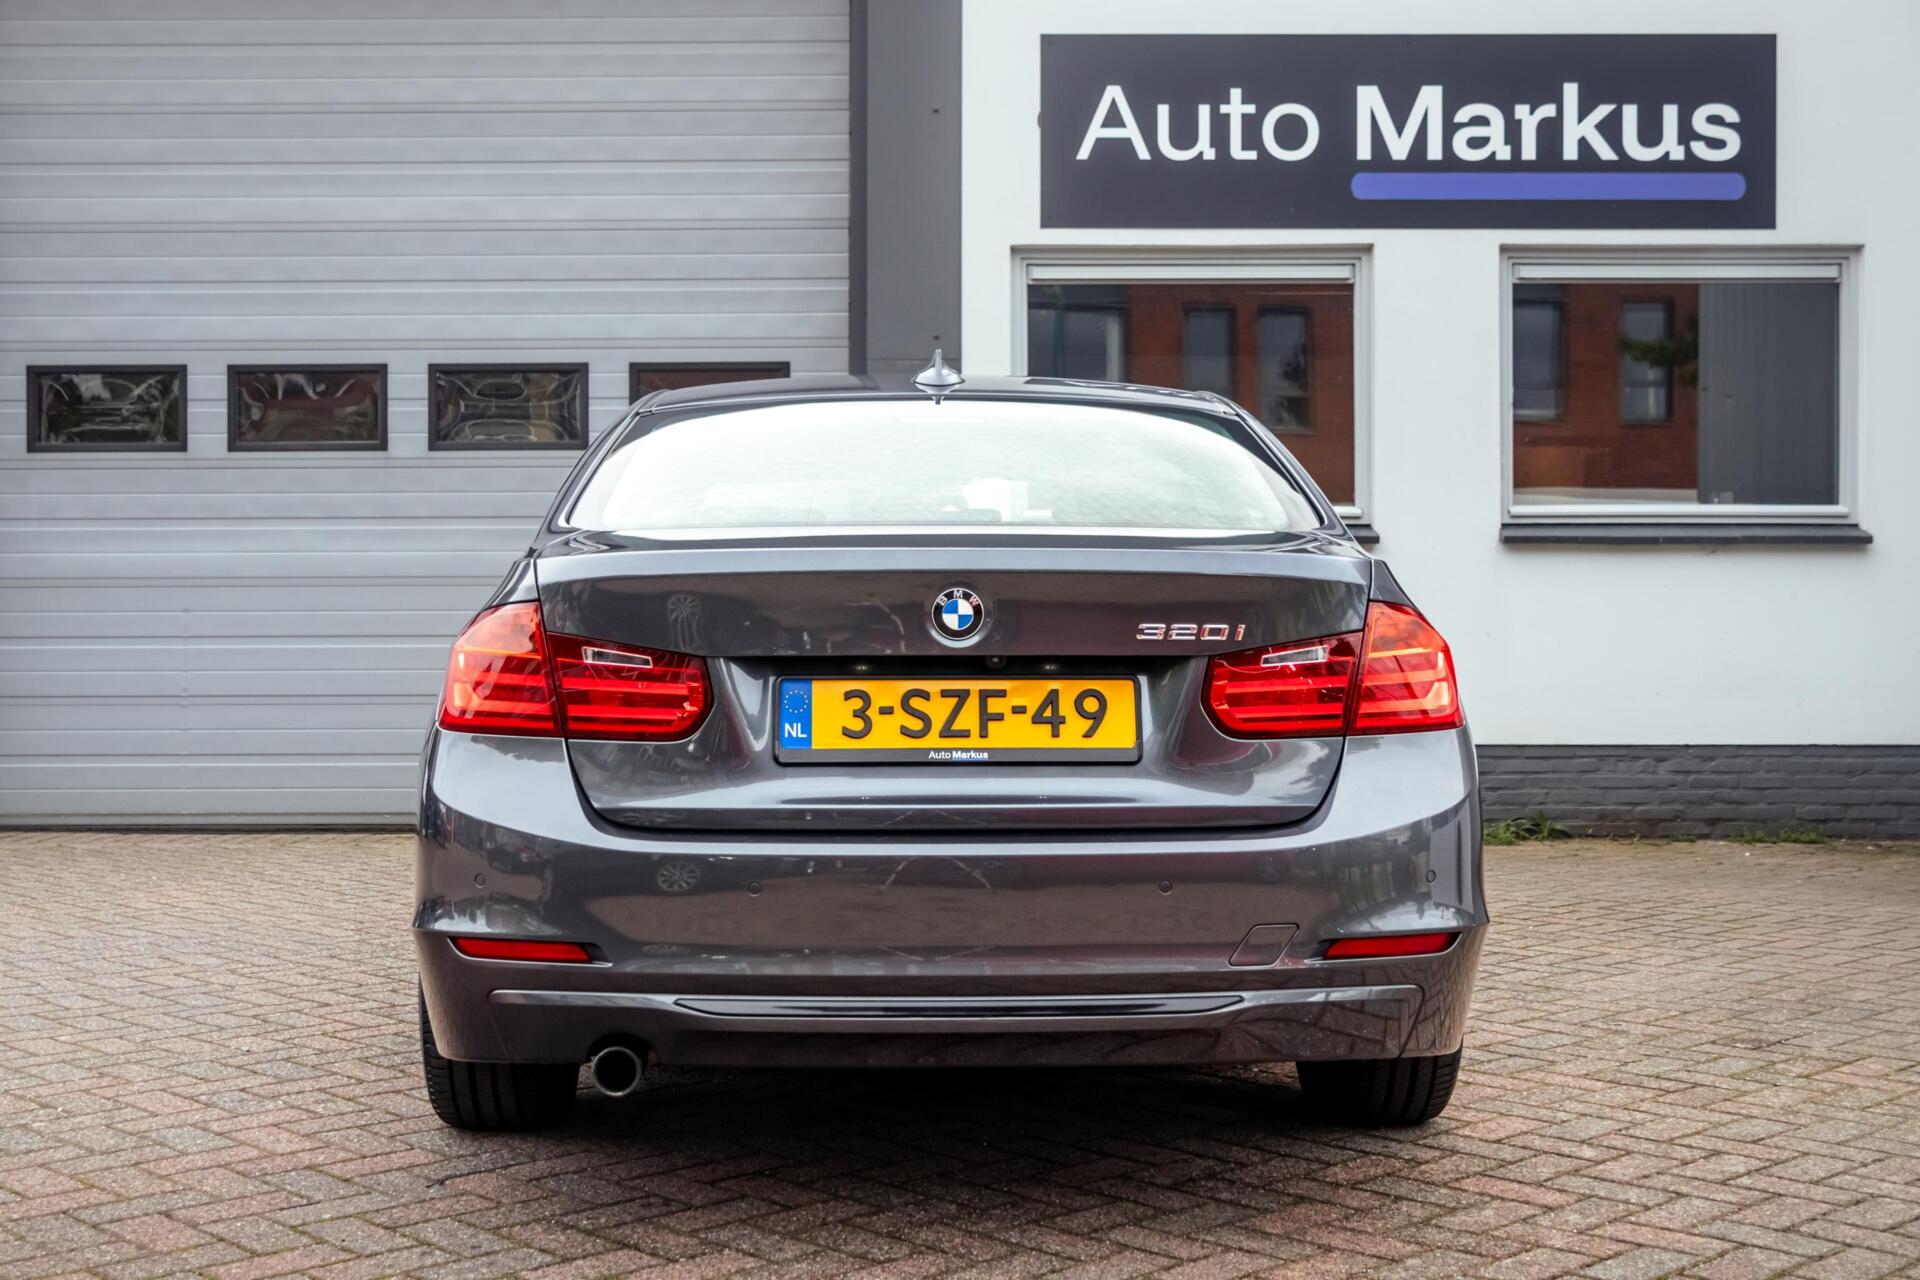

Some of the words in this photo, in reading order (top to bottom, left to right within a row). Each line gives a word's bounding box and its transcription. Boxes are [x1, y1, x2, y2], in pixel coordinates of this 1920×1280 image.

[1075, 84, 1321, 162] Auto
[1355, 82, 1743, 162] Markus
[936, 588, 981, 607] BMW
[1135, 623, 1246, 641] 320i
[841, 687, 1108, 740] 3-SZF-49
[784, 722, 807, 738] NL
[928, 750, 951, 759] Auto
[952, 750, 989, 760] Markus
